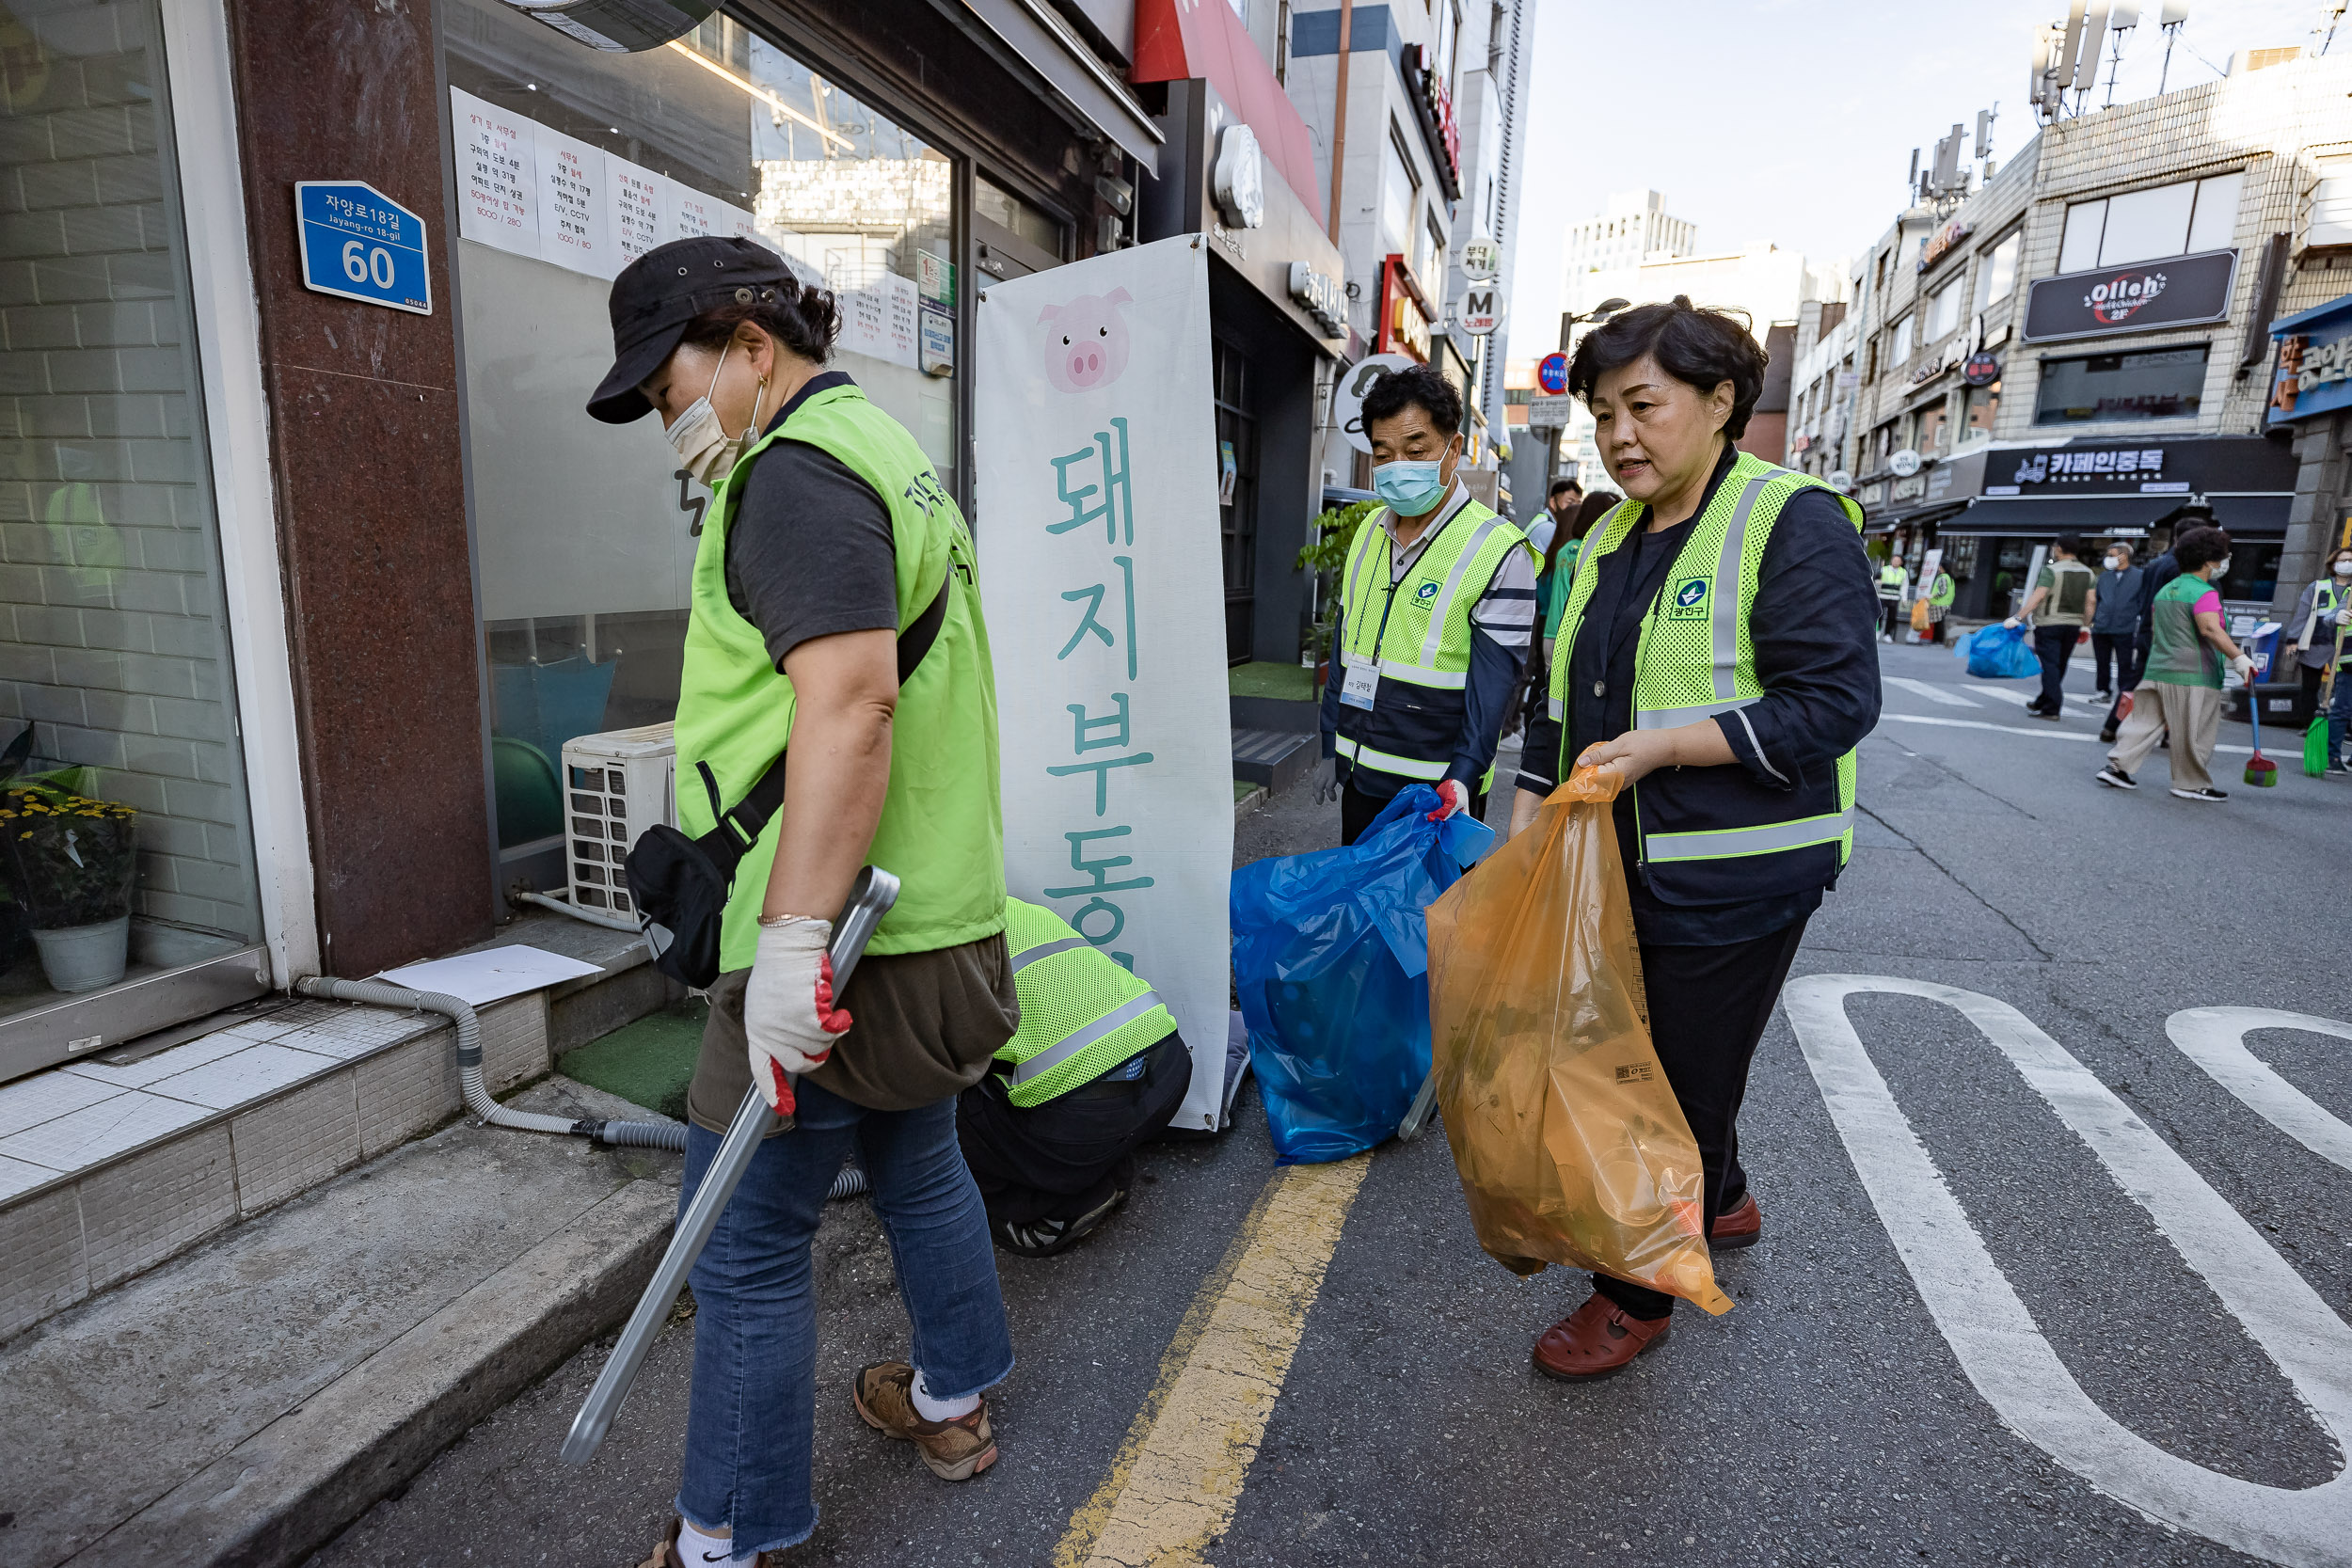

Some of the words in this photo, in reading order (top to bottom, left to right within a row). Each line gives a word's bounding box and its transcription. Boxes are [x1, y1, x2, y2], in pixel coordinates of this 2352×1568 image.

[481, 133, 489, 144] 1층
[494, 138, 507, 150] 월세
[497, 124, 516, 139] 사무실
[470, 143, 489, 159] 구의역
[493, 152, 505, 165] 도보
[509, 159, 519, 170] 4분
[561, 150, 577, 164] 사무실
[476, 162, 487, 174] 실평
[492, 167, 499, 178] 약
[501, 171, 516, 183] 31평
[558, 163, 566, 174] 9층
[571, 168, 581, 180] 월세
[471, 174, 490, 189] 아파트
[493, 182, 506, 195] 단지
[510, 188, 522, 200] 상권
[550, 174, 566, 187] 실평수
[570, 182, 576, 191] 약
[580, 185, 591, 197] 17평
[471, 189, 500, 207] 50평이상
[513, 204, 525, 215] 가능
[557, 191, 573, 204] 지하철
[577, 198, 585, 209] 5분
[618, 199, 633, 213] 구의역
[636, 207, 645, 217] 도보
[648, 212, 657, 221] 4분
[326, 194, 400, 230] 자양로18길
[477, 207, 498, 219] 5000
[507, 216, 521, 228] 280
[570, 210, 590, 221] CCTV
[329, 214, 373, 233] Jayang-ro
[376, 228, 401, 241] 18-gil
[561, 220, 571, 230] 주차
[621, 214, 635, 226] 실평수
[646, 223, 654, 233] 7평
[557, 232, 574, 244] 1000
[582, 241, 591, 249] 80
[637, 232, 654, 245] CCTV
[342, 240, 395, 290] 60
[2091, 277, 2158, 302] Olleh
[405, 298, 427, 309] 05044
[1468, 293, 1493, 314] M
[2110, 309, 2129, 320] 2F
[2049, 449, 2164, 474] 카페인중독
[1674, 607, 1705, 617] 광진구
[1043, 417, 1154, 974] 돼지부동
